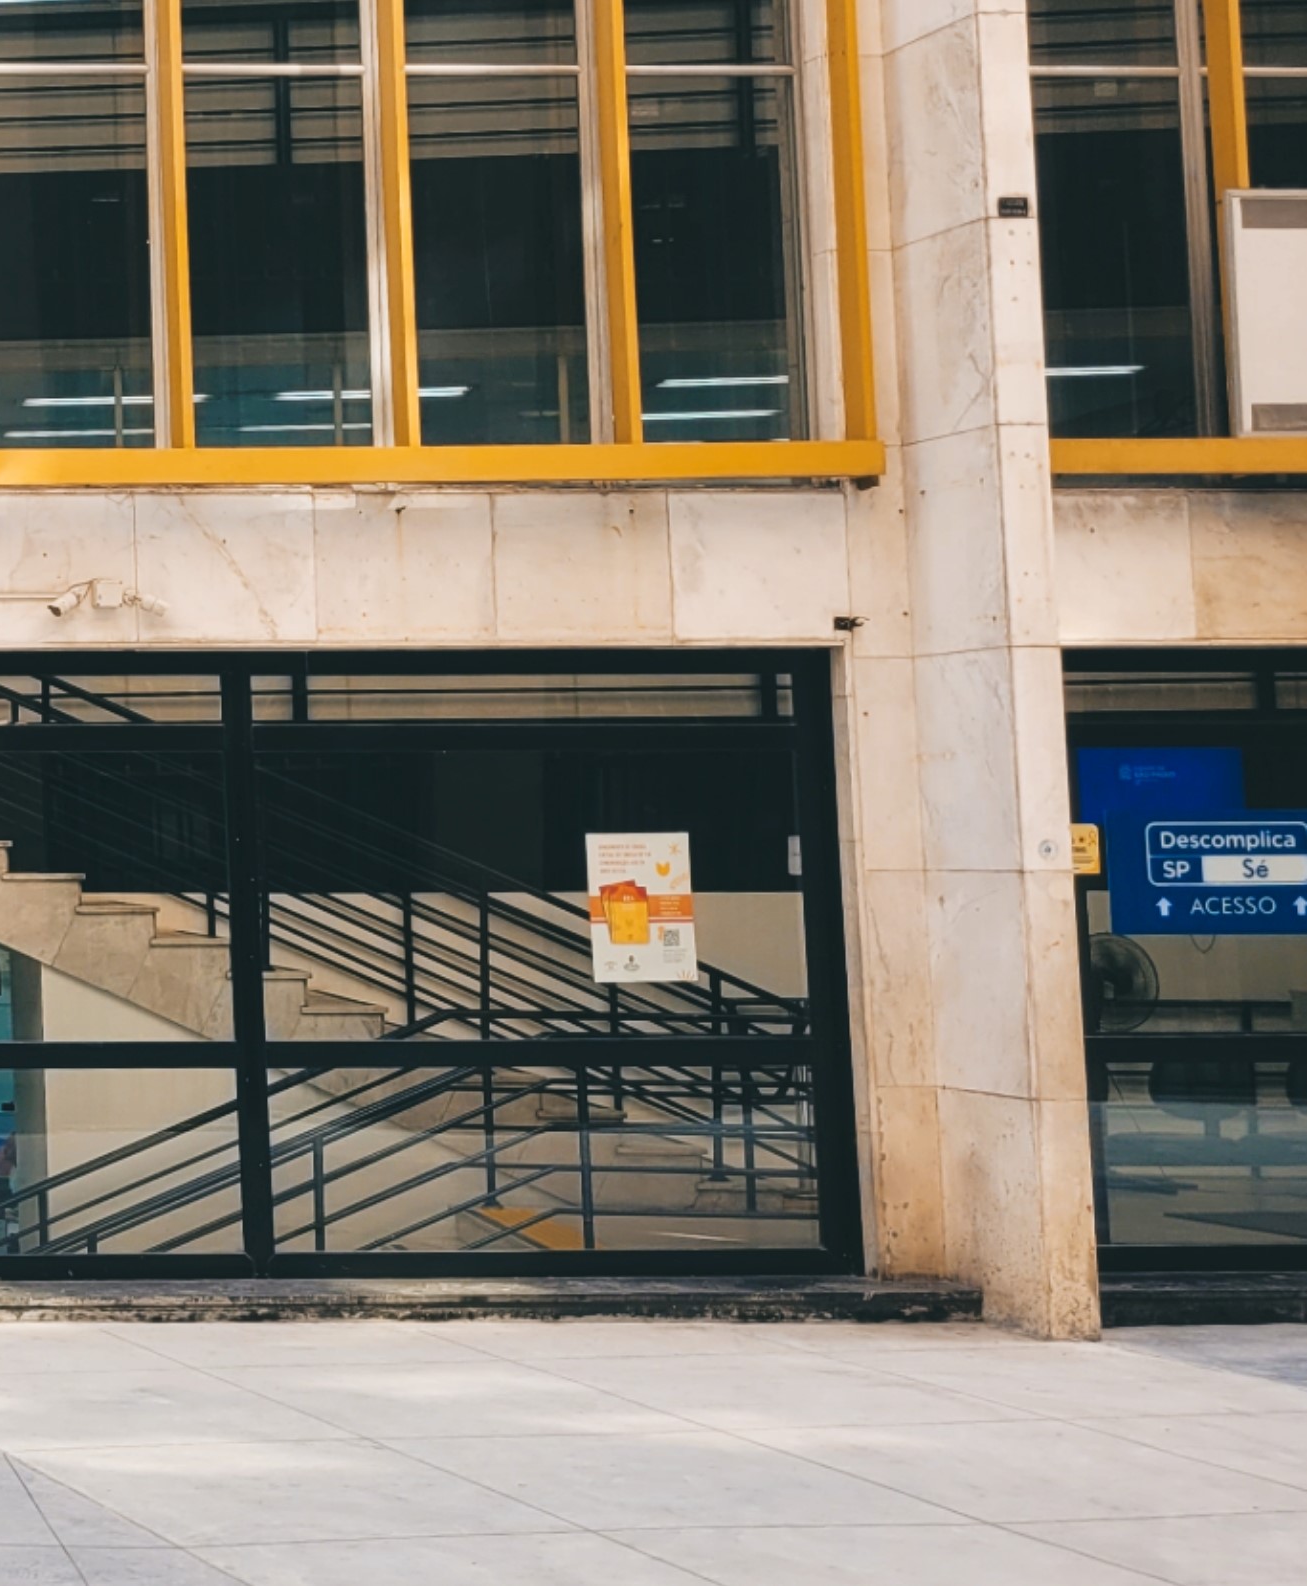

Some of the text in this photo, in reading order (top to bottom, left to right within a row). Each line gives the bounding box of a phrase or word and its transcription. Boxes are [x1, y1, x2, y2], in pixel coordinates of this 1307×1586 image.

[1160, 830, 1297, 852] Descomplica
[1162, 857, 1270, 879] SP Sé
[1189, 896, 1277, 916] ACESSO
